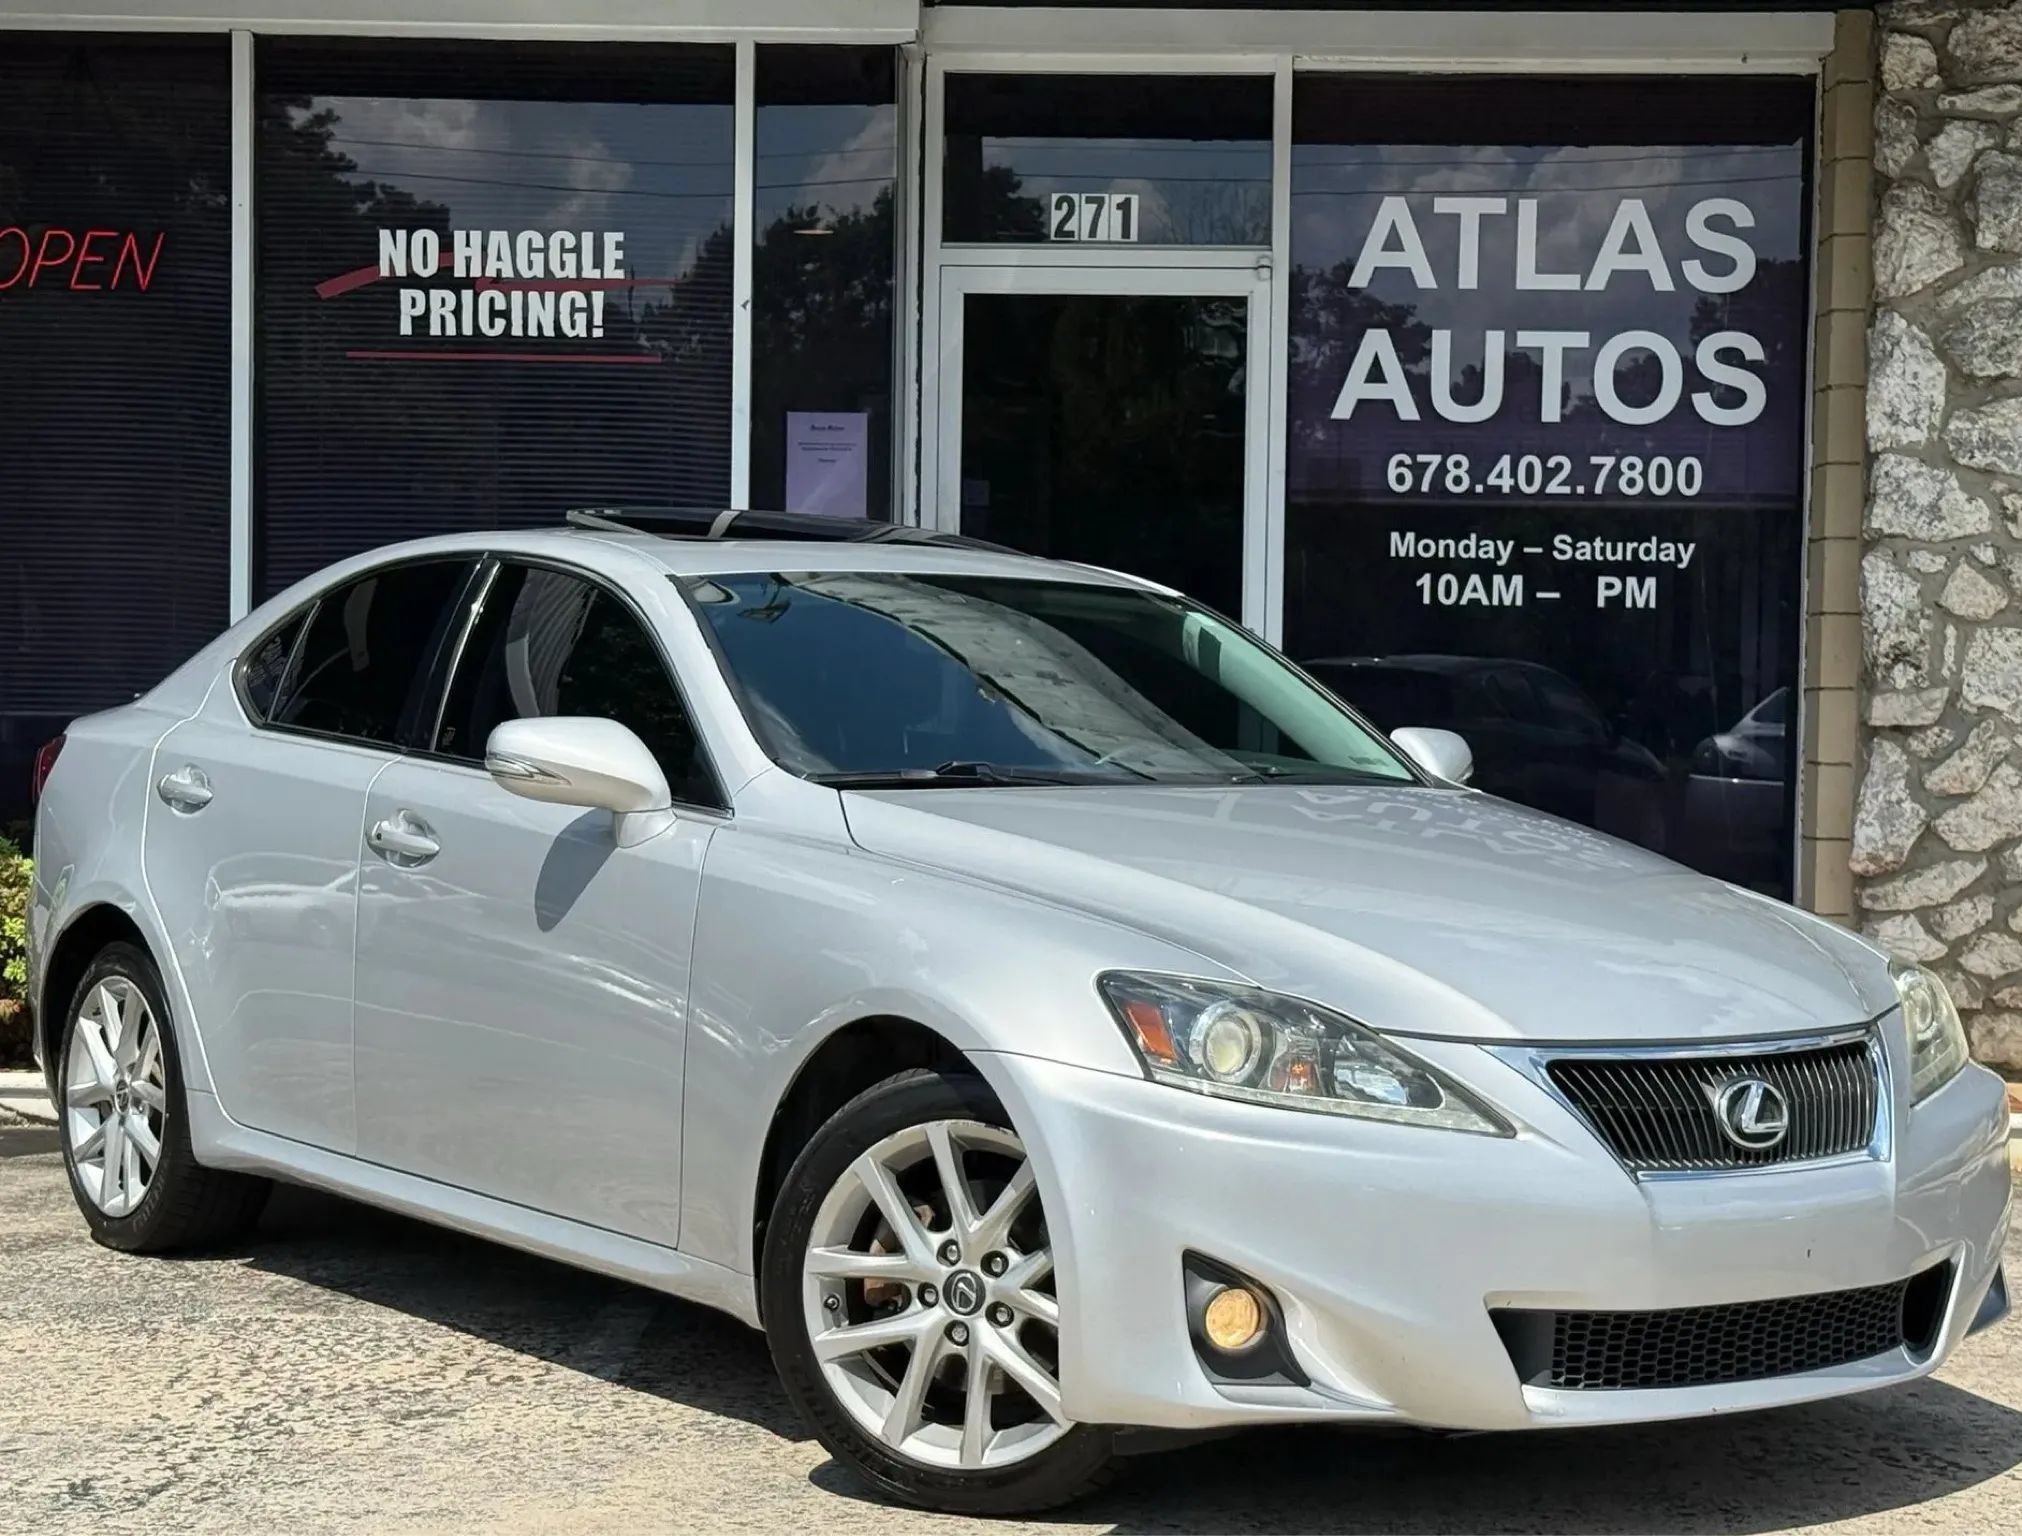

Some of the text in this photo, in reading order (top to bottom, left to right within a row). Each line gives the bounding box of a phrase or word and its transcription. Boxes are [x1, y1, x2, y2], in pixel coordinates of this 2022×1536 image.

[1052, 194, 1134, 241] 271
[0, 228, 165, 291] OPEN
[379, 228, 627, 280] NO HAGGLE
[1347, 195, 1757, 295] ATLAS
[399, 288, 605, 338] PRICING!
[1330, 328, 1768, 427] AUTOS
[1386, 452, 1704, 497] 678.402.7800
[1389, 531, 1515, 568] Monday
[1552, 534, 1697, 570] Saturday
[1415, 572, 1524, 608] 10AM
[1596, 575, 1658, 610] PM
